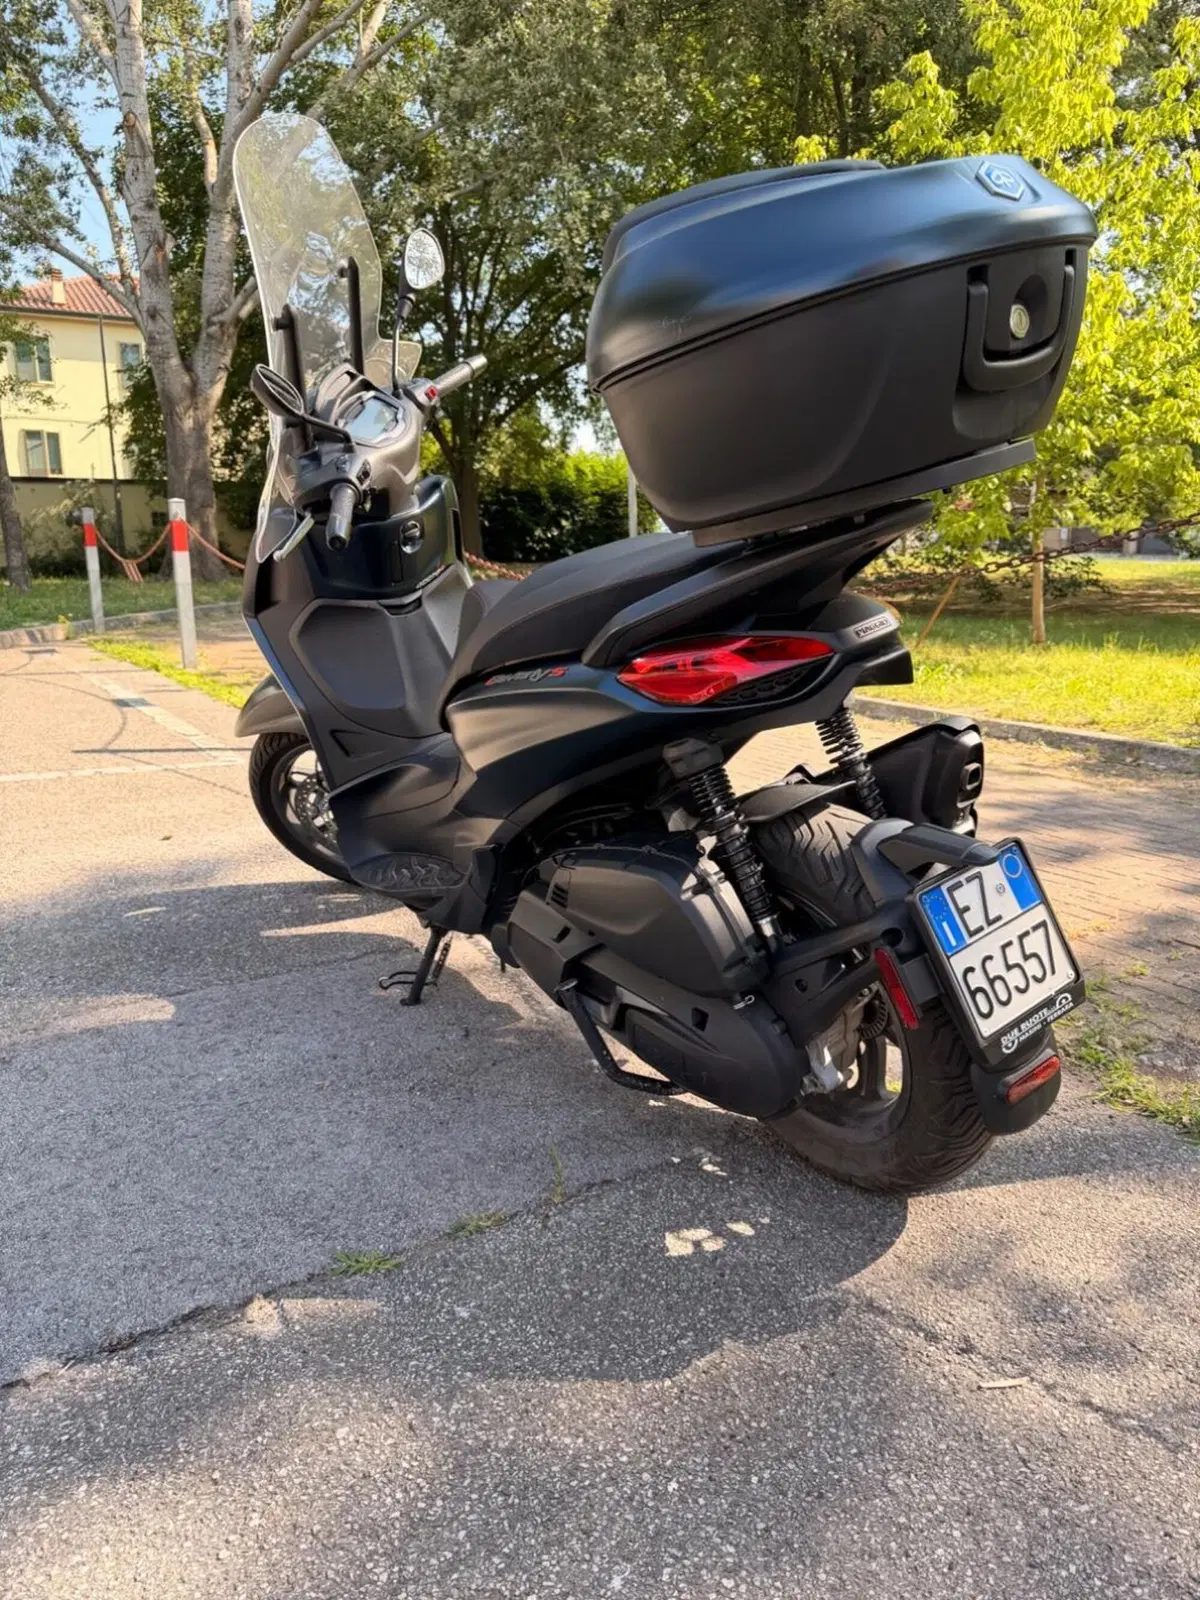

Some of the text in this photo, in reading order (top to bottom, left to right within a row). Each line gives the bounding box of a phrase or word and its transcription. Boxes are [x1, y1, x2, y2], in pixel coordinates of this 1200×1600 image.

[947, 871, 1003, 938] EZ
[962, 919, 1056, 1019] 66557
[1001, 1027, 1020, 1046] DUE
[1020, 1007, 1050, 1032] RUOTE
